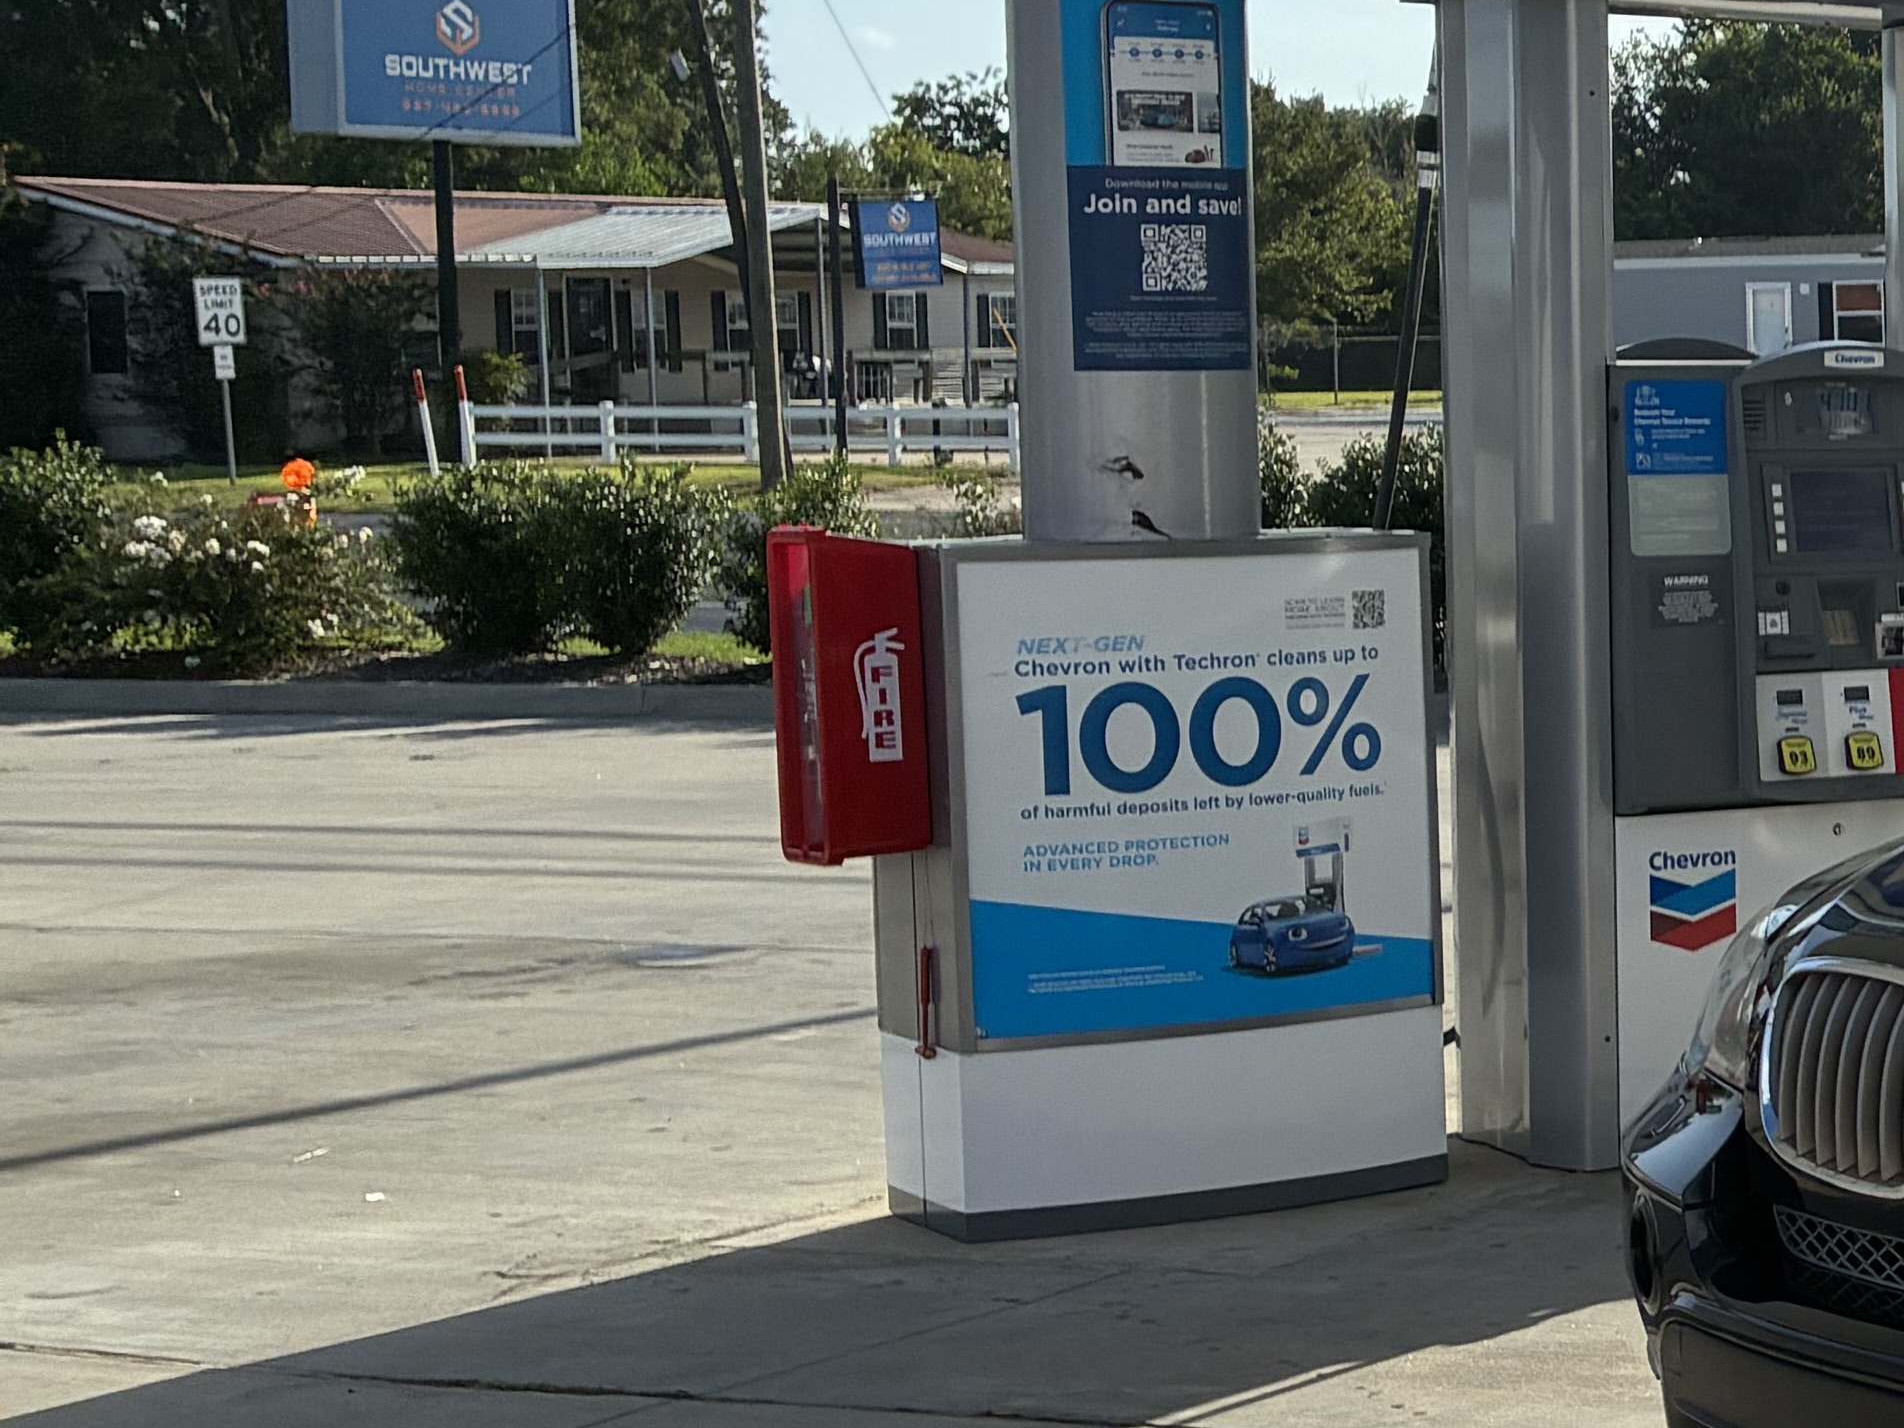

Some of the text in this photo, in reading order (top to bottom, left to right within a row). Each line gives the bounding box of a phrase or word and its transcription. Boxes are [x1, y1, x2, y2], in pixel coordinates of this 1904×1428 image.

[385, 54, 532, 85] SOUTHWEST
[1084, 193, 1241, 216] Join and save!
[863, 232, 937, 247] SOUTHWEST
[199, 284, 237, 296] SPEED
[204, 298, 233, 310] LIMIT
[203, 313, 240, 338] 40
[1835, 354, 1876, 364] Chevron
[1664, 575, 1709, 586] WARNING
[1017, 635, 1146, 655] NEXT-GEN
[1015, 645, 1379, 677] Chevron with Techron cleans up to
[871, 665, 896, 749] FIRE
[1015, 673, 1381, 796] 100%
[1021, 783, 1384, 820] of harmful deposits left by lower-quality fuels.
[1024, 834, 1229, 858] ADVANCED PROTECTION
[1024, 853, 1158, 872] IN EVERY DROP.
[1649, 850, 1736, 871] Chevron
